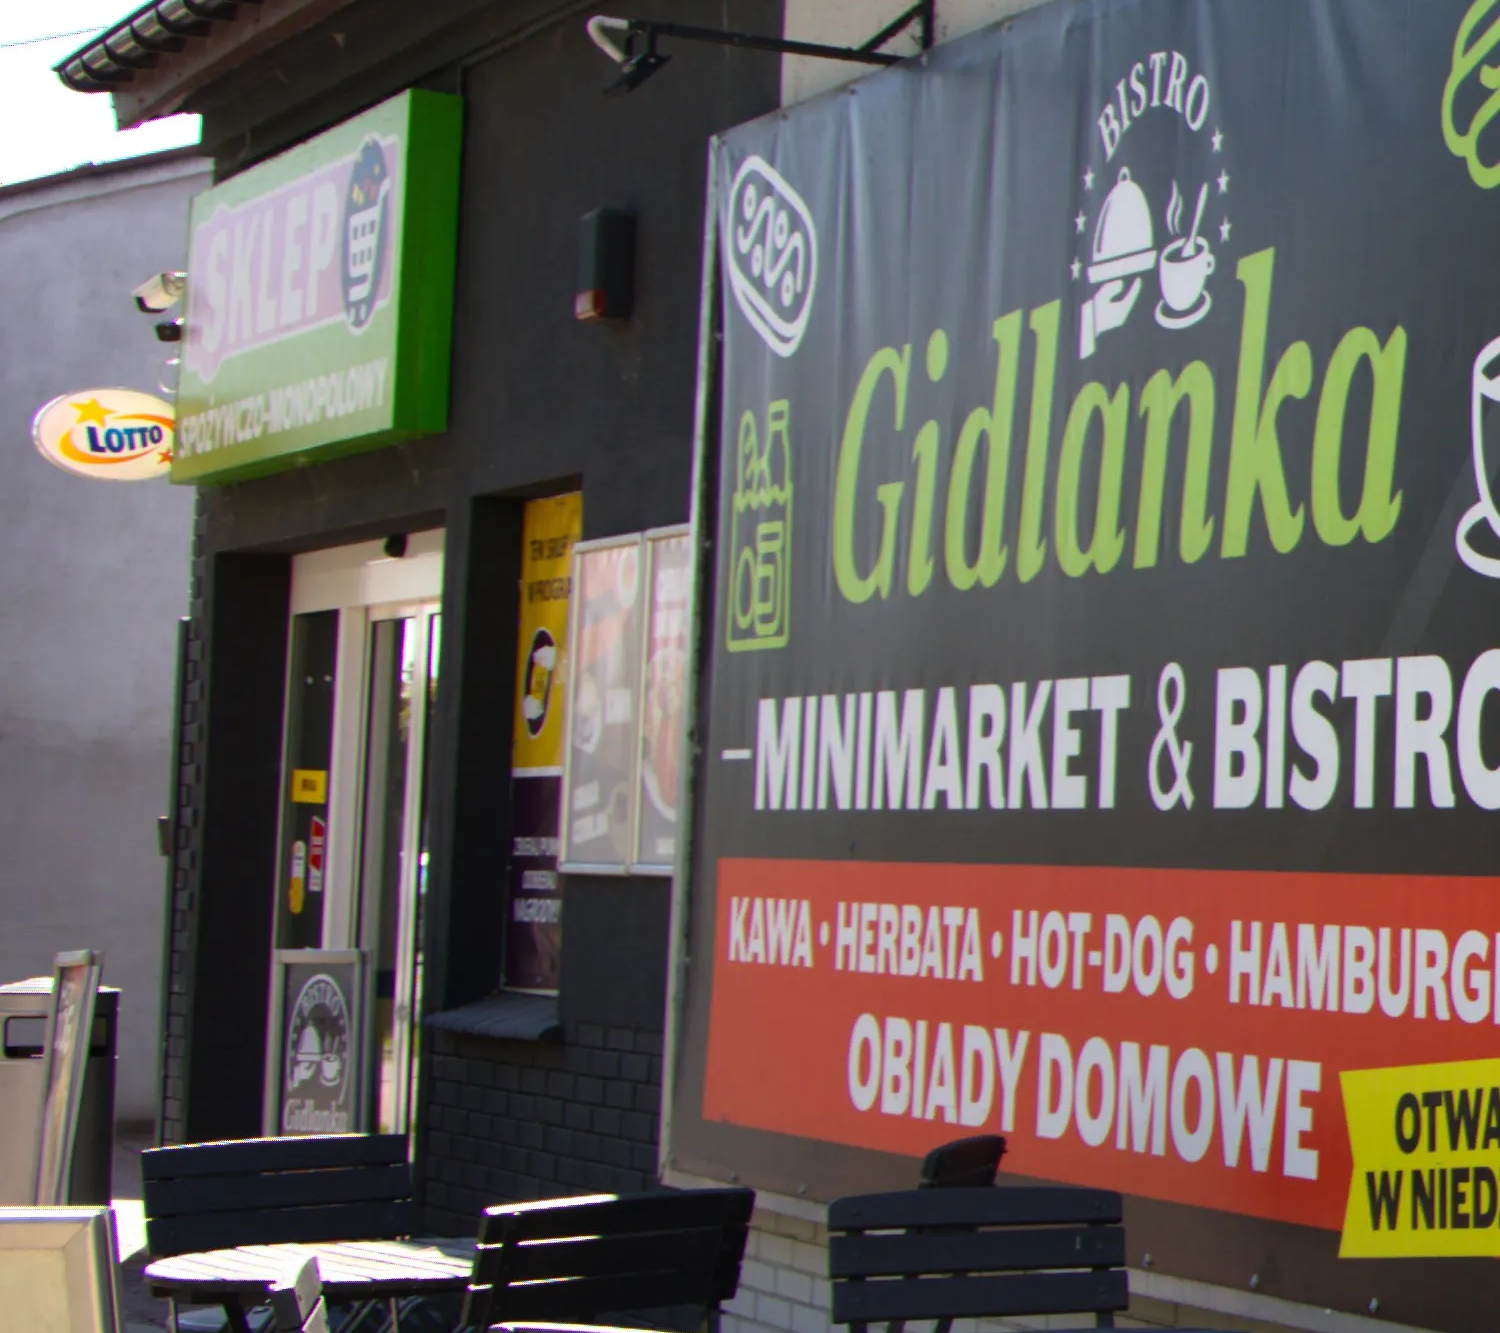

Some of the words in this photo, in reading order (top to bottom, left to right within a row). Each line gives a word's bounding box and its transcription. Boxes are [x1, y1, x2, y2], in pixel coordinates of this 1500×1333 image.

[1097, 49, 1210, 163] BISTRO
[202, 180, 338, 354] SKLEP
[87, 425, 164, 454] LOTTO
[832, 246, 1407, 603] Gidlanka
[753, 675, 1131, 811] MINIMARKET
[1149, 662, 1195, 812] &
[728, 896, 814, 969] KAWA
[835, 902, 984, 983] HERBATA
[1011, 909, 1195, 1000] HOT-DOG
[847, 1013, 1031, 1129] OBIADY
[1038, 1031, 1322, 1181] DOMOWE
[1366, 1171, 1403, 1231] W
